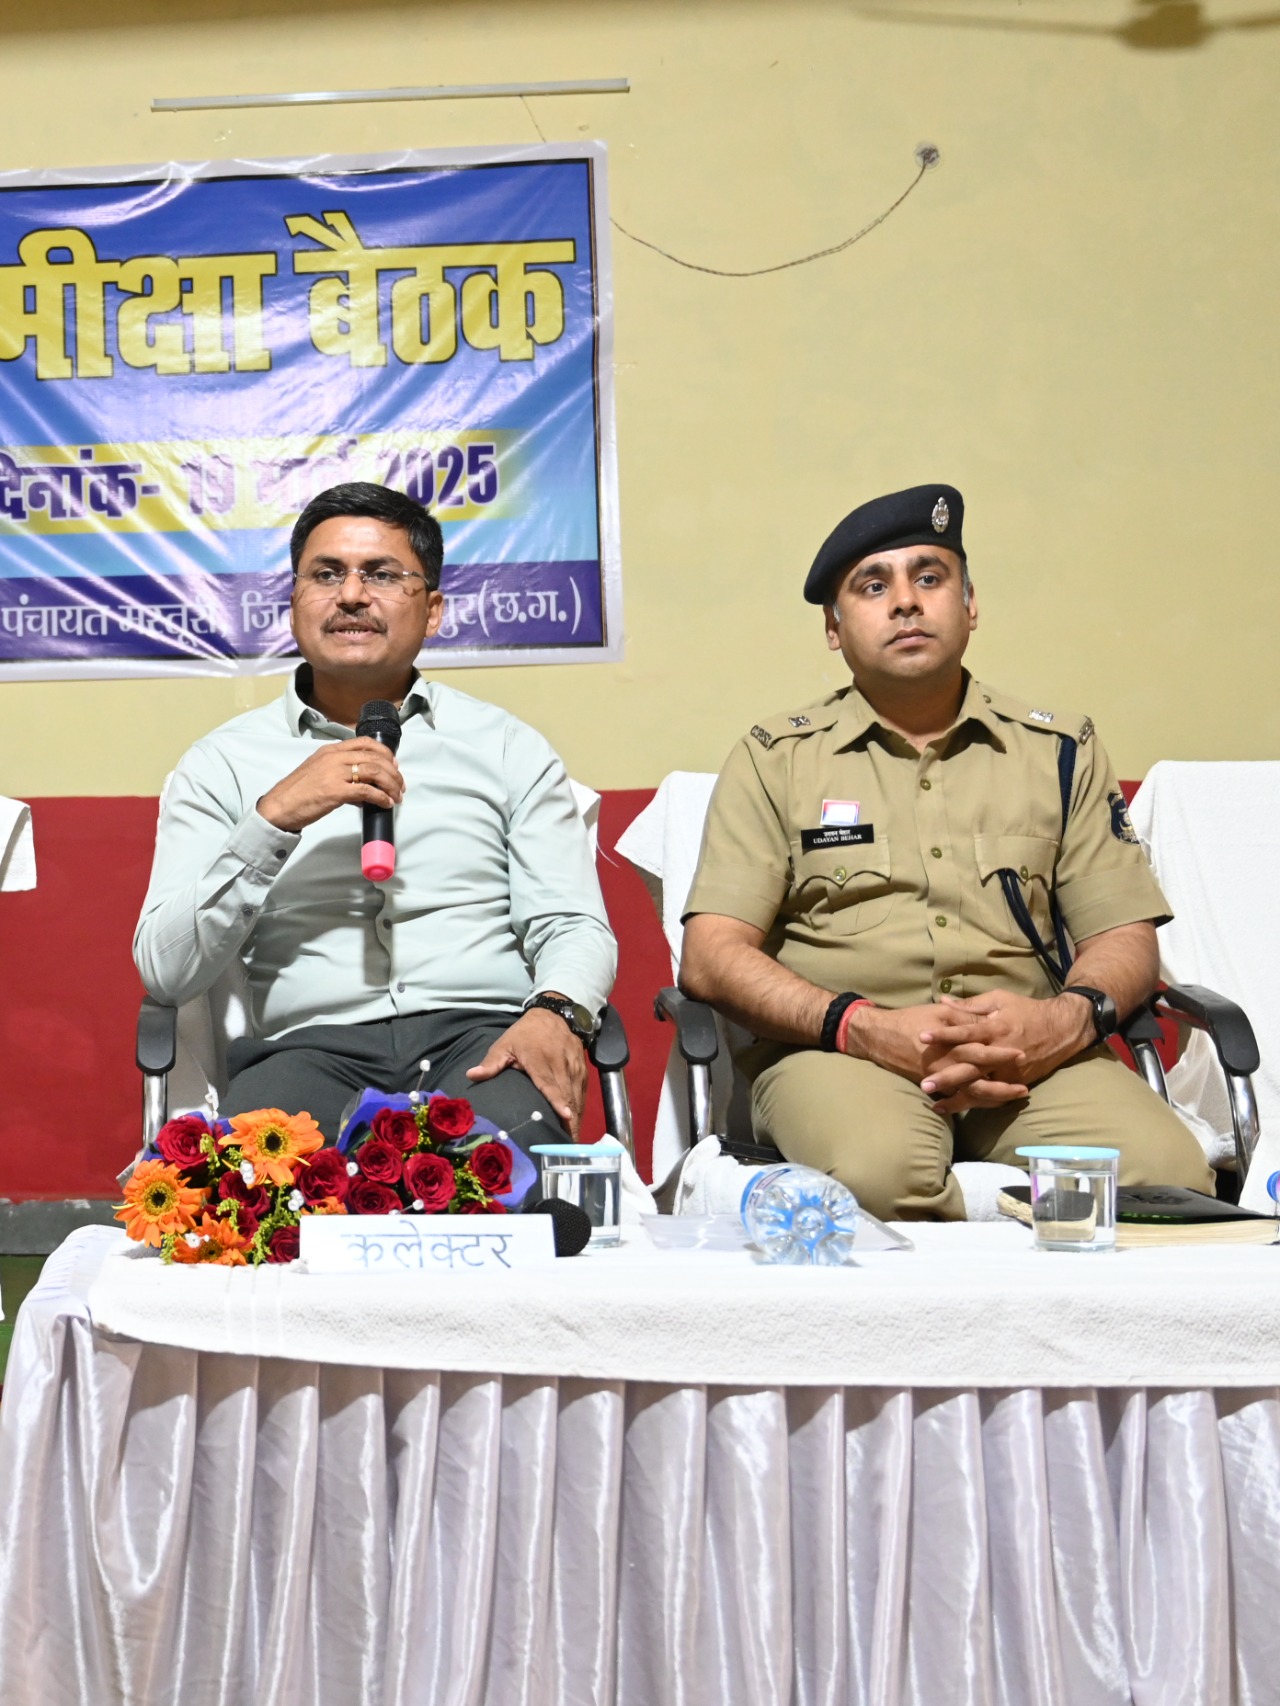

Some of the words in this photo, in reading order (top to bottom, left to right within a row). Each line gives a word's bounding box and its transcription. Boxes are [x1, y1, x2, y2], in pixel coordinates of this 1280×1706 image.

[284, 210, 577, 367] बैठक
[180, 453, 235, 516] 19
[375, 443, 498, 508] 2025
[1, 593, 110, 638] पंचायत
[813, 836, 839, 844] UDAYAN
[840, 834, 862, 842] BEHAR
[340, 1219, 513, 1269] कलेक्टर
